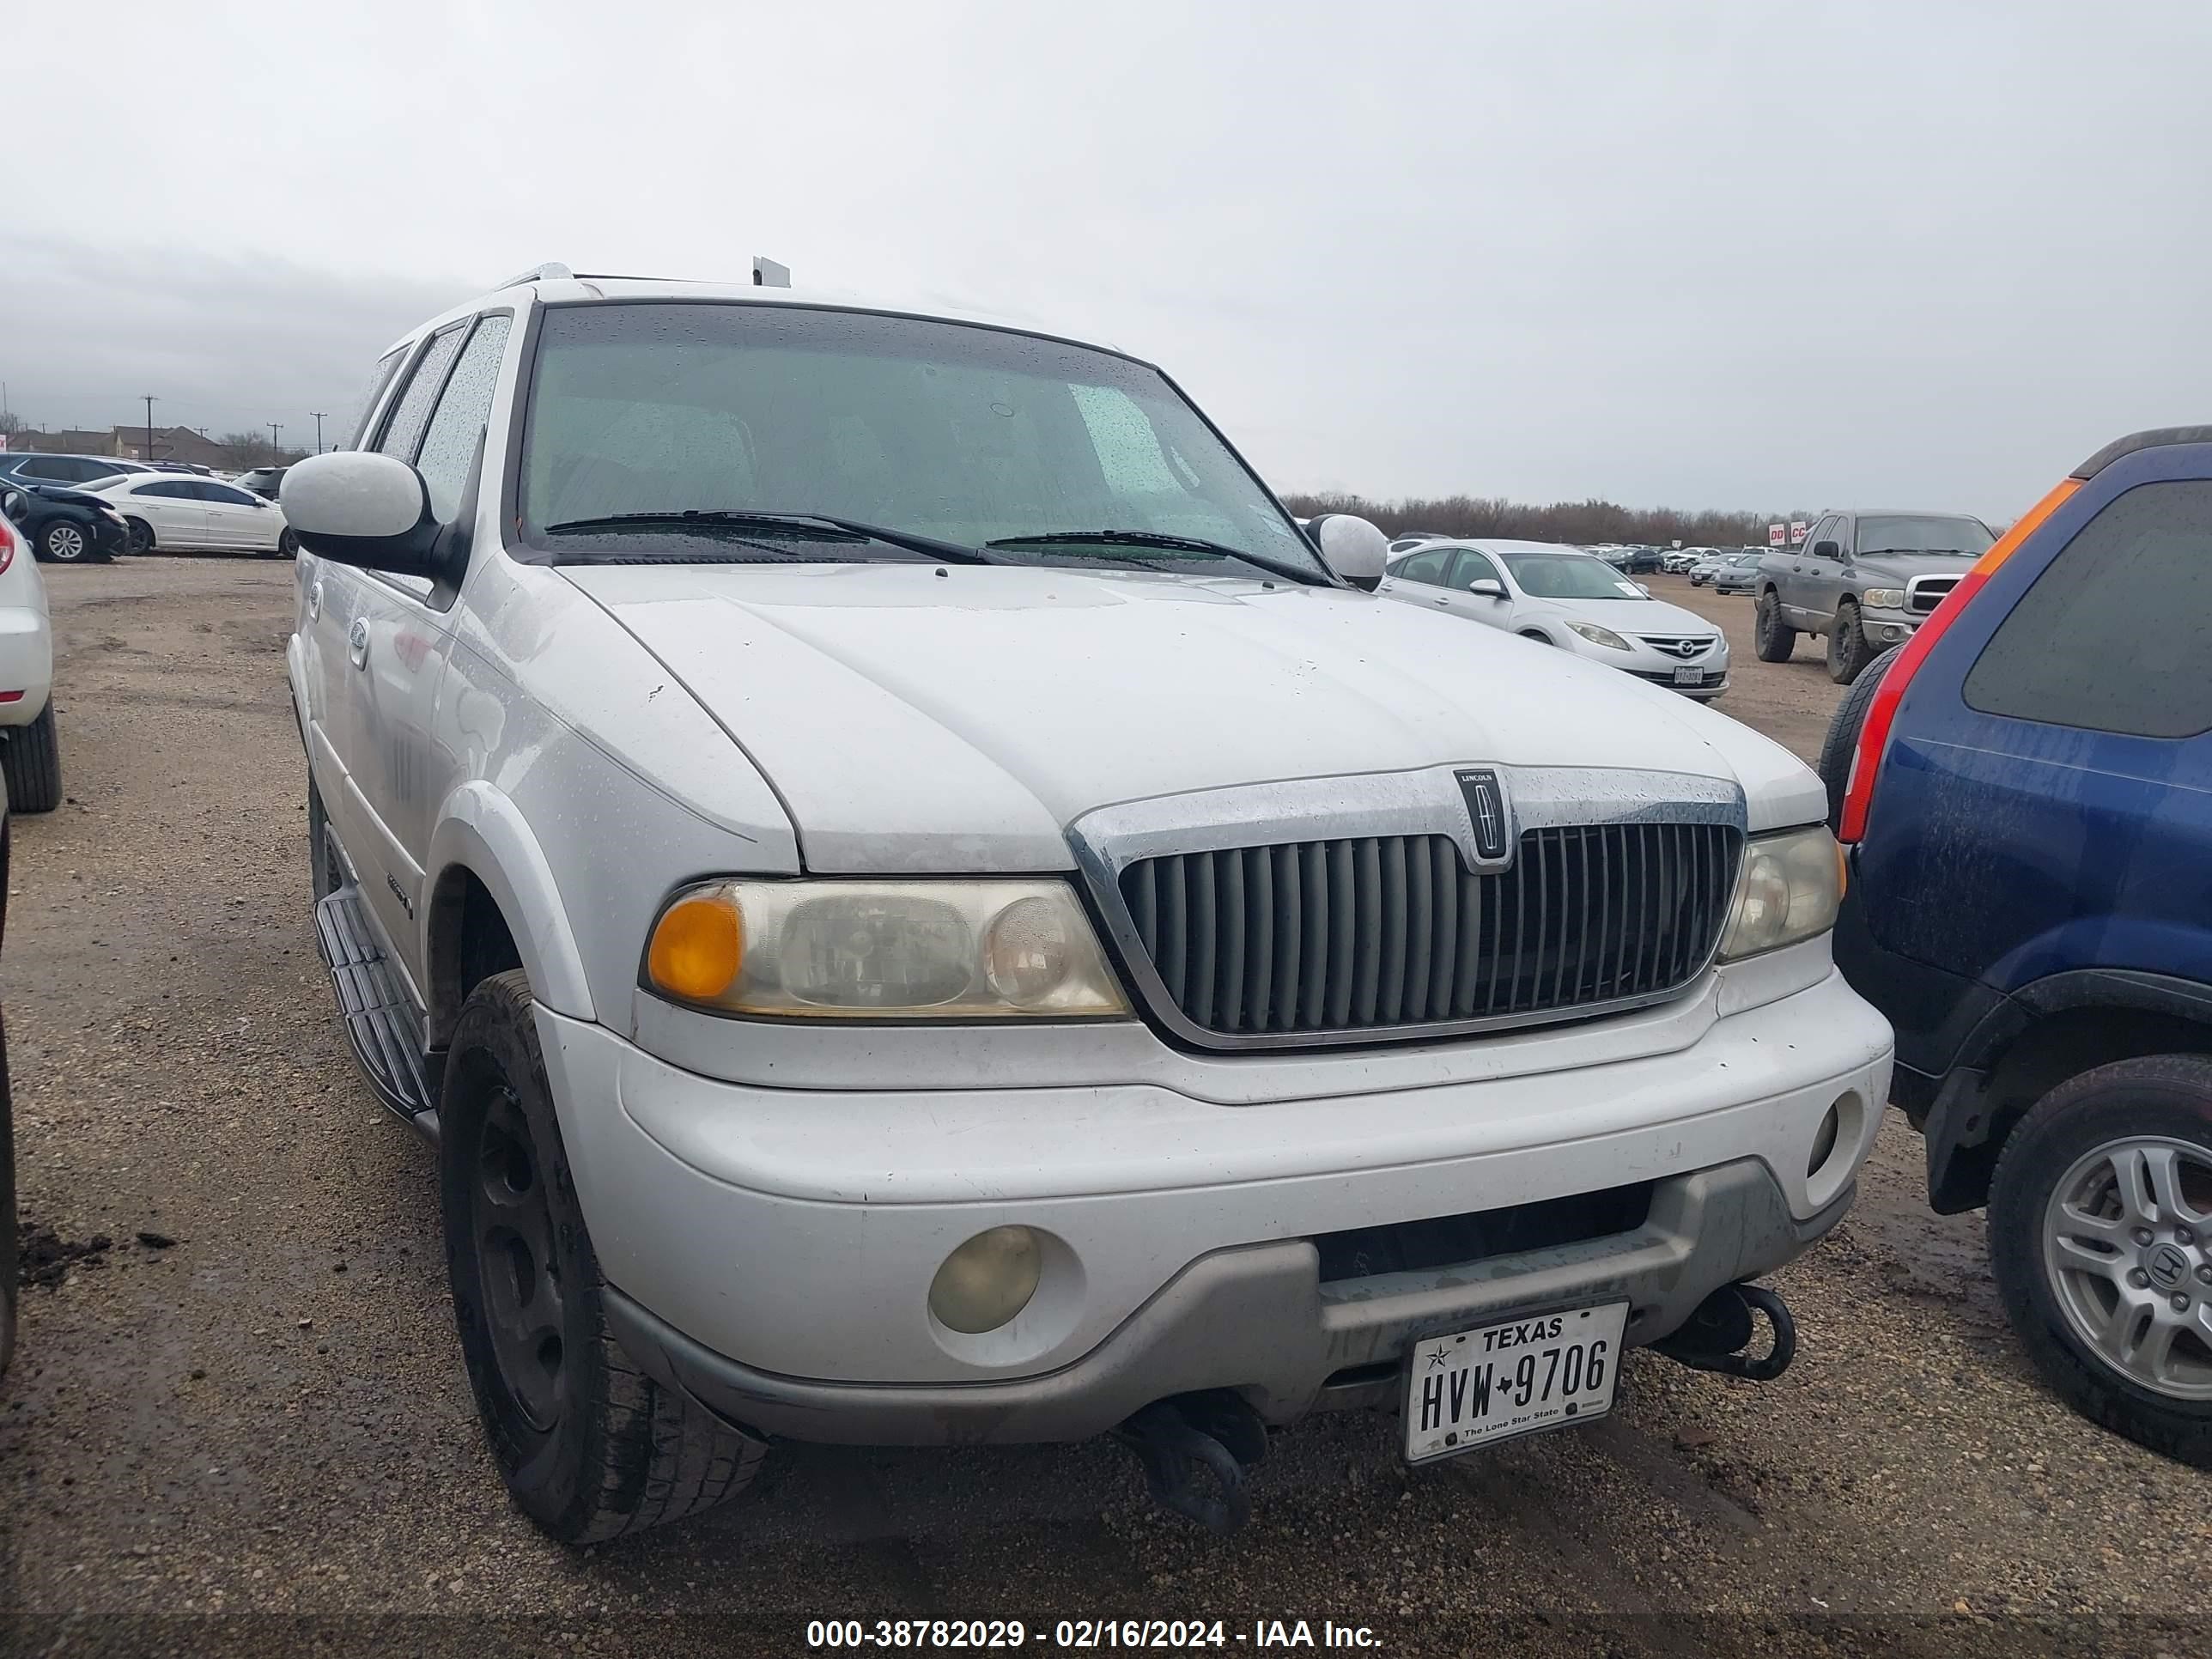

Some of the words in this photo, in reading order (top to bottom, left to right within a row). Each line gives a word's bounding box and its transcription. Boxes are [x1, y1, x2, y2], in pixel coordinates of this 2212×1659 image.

[1771, 530, 1784, 540] DD
[1792, 527, 1805, 538] CC
[1483, 1317, 1563, 1352] TEXAS
[1421, 1363, 1493, 1431] HVW
[1514, 1340, 1607, 1407] 9706
[1464, 1427, 1483, 1437] The
[1486, 1420, 1509, 1432] Lone
[1511, 1414, 1530, 1426] Star
[1533, 1407, 1559, 1419] State
